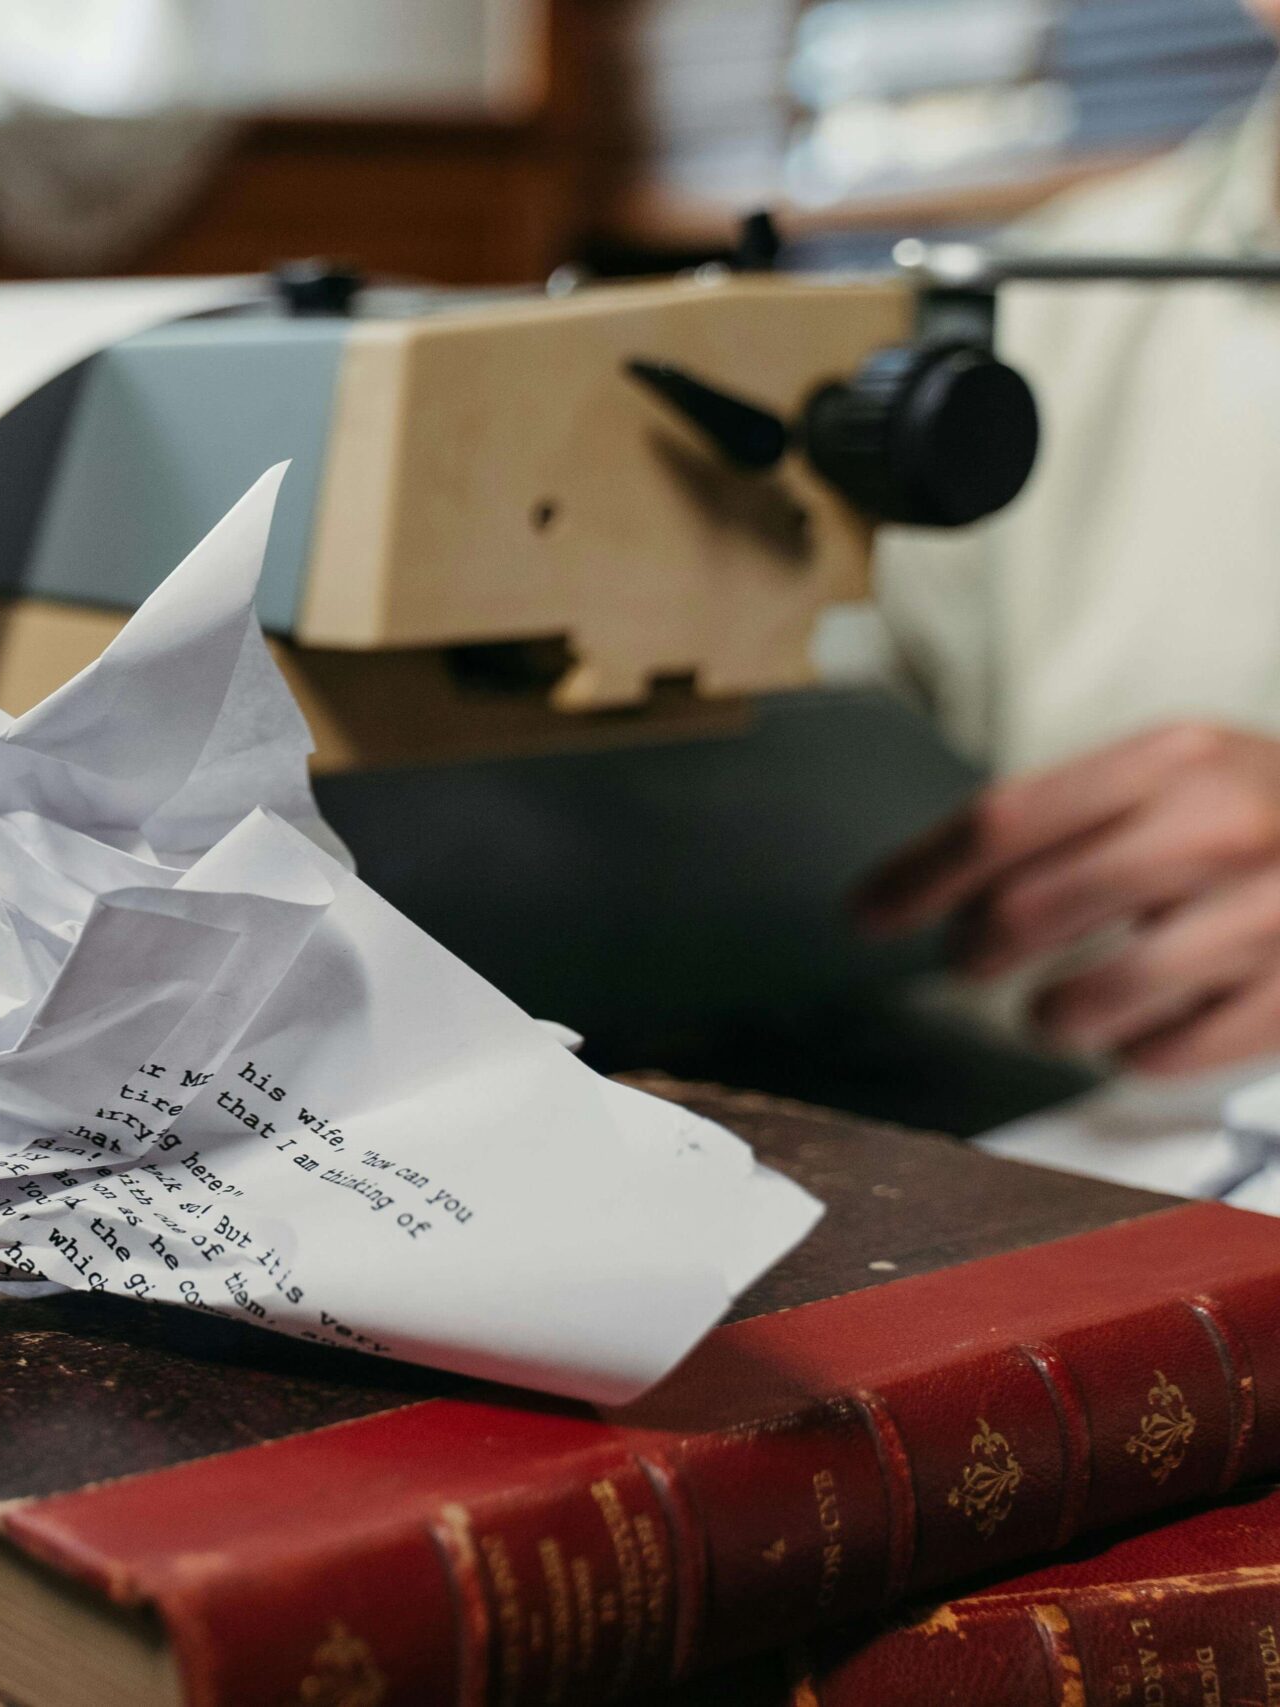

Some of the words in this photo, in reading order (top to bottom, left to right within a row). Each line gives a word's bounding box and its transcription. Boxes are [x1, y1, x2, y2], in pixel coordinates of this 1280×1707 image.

[181, 1151, 244, 1196] here?"
[216, 1090, 276, 1140] that
[276, 1139, 298, 1151] I
[293, 1153, 320, 1172] am
[320, 1168, 395, 1211] thinking
[396, 1213, 433, 1239] of
[238, 1061, 287, 1102] his
[297, 1107, 345, 1153] wife,
[361, 1150, 396, 1171] "how
[395, 1167, 429, 1189] can
[426, 1189, 473, 1224] you
[18, 1181, 52, 1205] You
[90, 1217, 131, 1262] the
[52, 1169, 78, 1187] as
[118, 1206, 143, 1226] as
[149, 1234, 179, 1270] he
[140, 1164, 183, 1192] talk
[179, 1203, 213, 1218] so!
[214, 1215, 252, 1248] But
[191, 1235, 225, 1262] of
